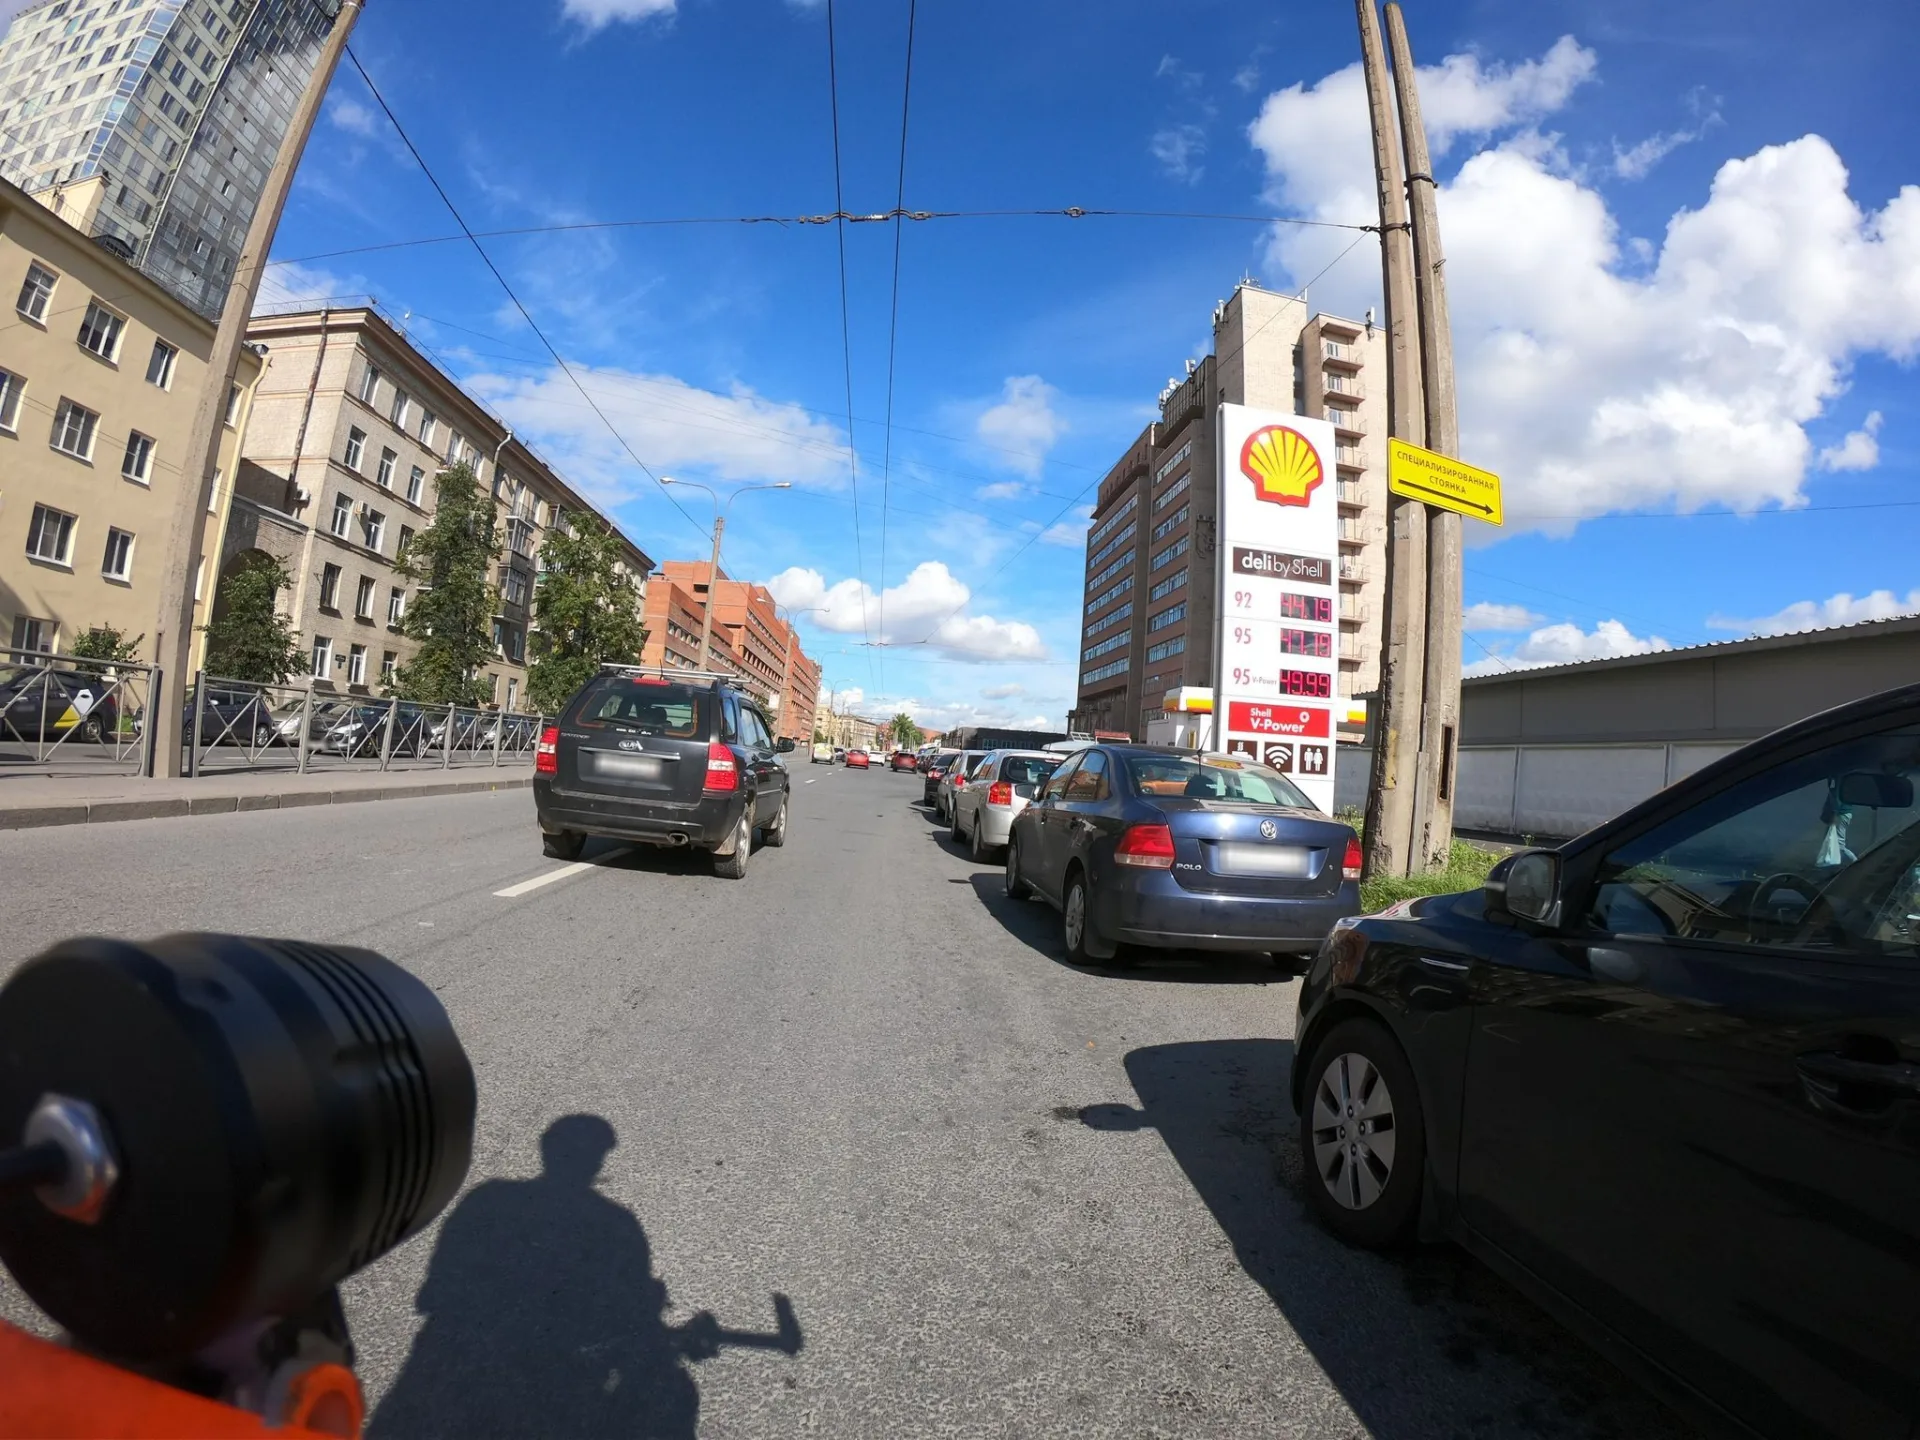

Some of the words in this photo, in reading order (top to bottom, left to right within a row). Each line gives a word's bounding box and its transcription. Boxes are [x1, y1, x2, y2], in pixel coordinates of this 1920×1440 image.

[1397, 451, 1494, 490] СПЕЦИАЛИЗИРОВАННАЯ
[1429, 475, 1467, 495] СТОЯНКА
[1241, 551, 1272, 571] deli
[1273, 555, 1291, 577] by
[1292, 559, 1323, 578] Shell
[1234, 591, 1252, 608] 92
[1280, 592, 1331, 622] 44.19
[1234, 627, 1251, 644] 95
[1280, 628, 1331, 657] 47.19
[1233, 668, 1251, 685] 95
[1252, 676, 1277, 686] V-Power
[1280, 670, 1330, 698] 49.99
[1250, 707, 1272, 718] Shell
[1250, 718, 1305, 732] V-Power
[1176, 863, 1202, 871] POLO
